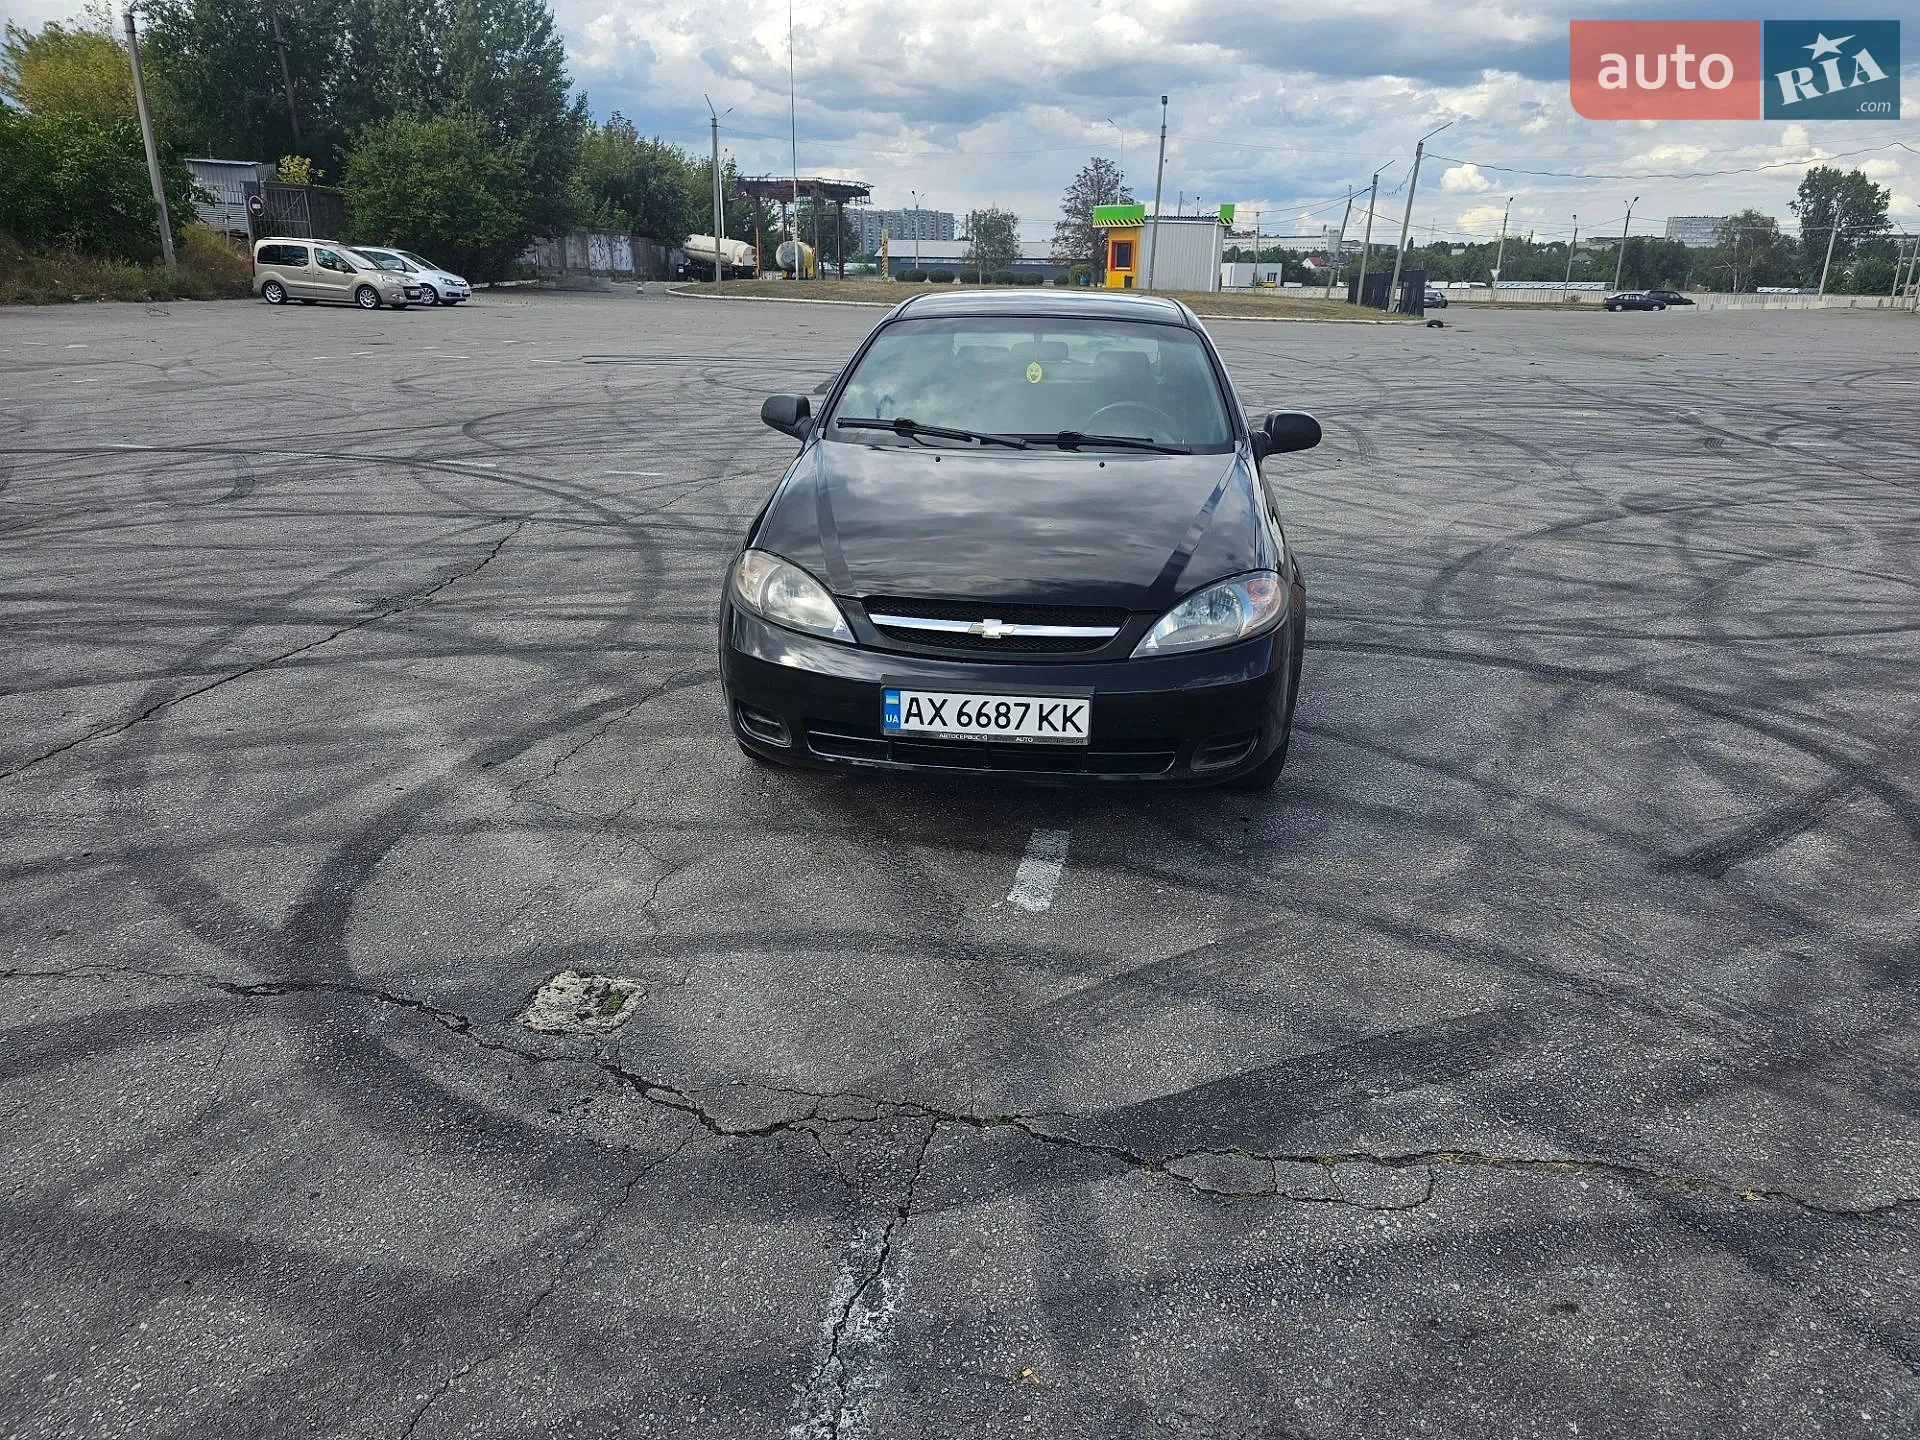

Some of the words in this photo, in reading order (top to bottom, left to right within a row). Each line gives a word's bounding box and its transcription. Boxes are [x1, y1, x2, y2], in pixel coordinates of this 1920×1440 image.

[885, 713, 899, 724] UA
[903, 697, 949, 727] AX
[956, 699, 1031, 730] 6687
[1037, 703, 1085, 733] KK
